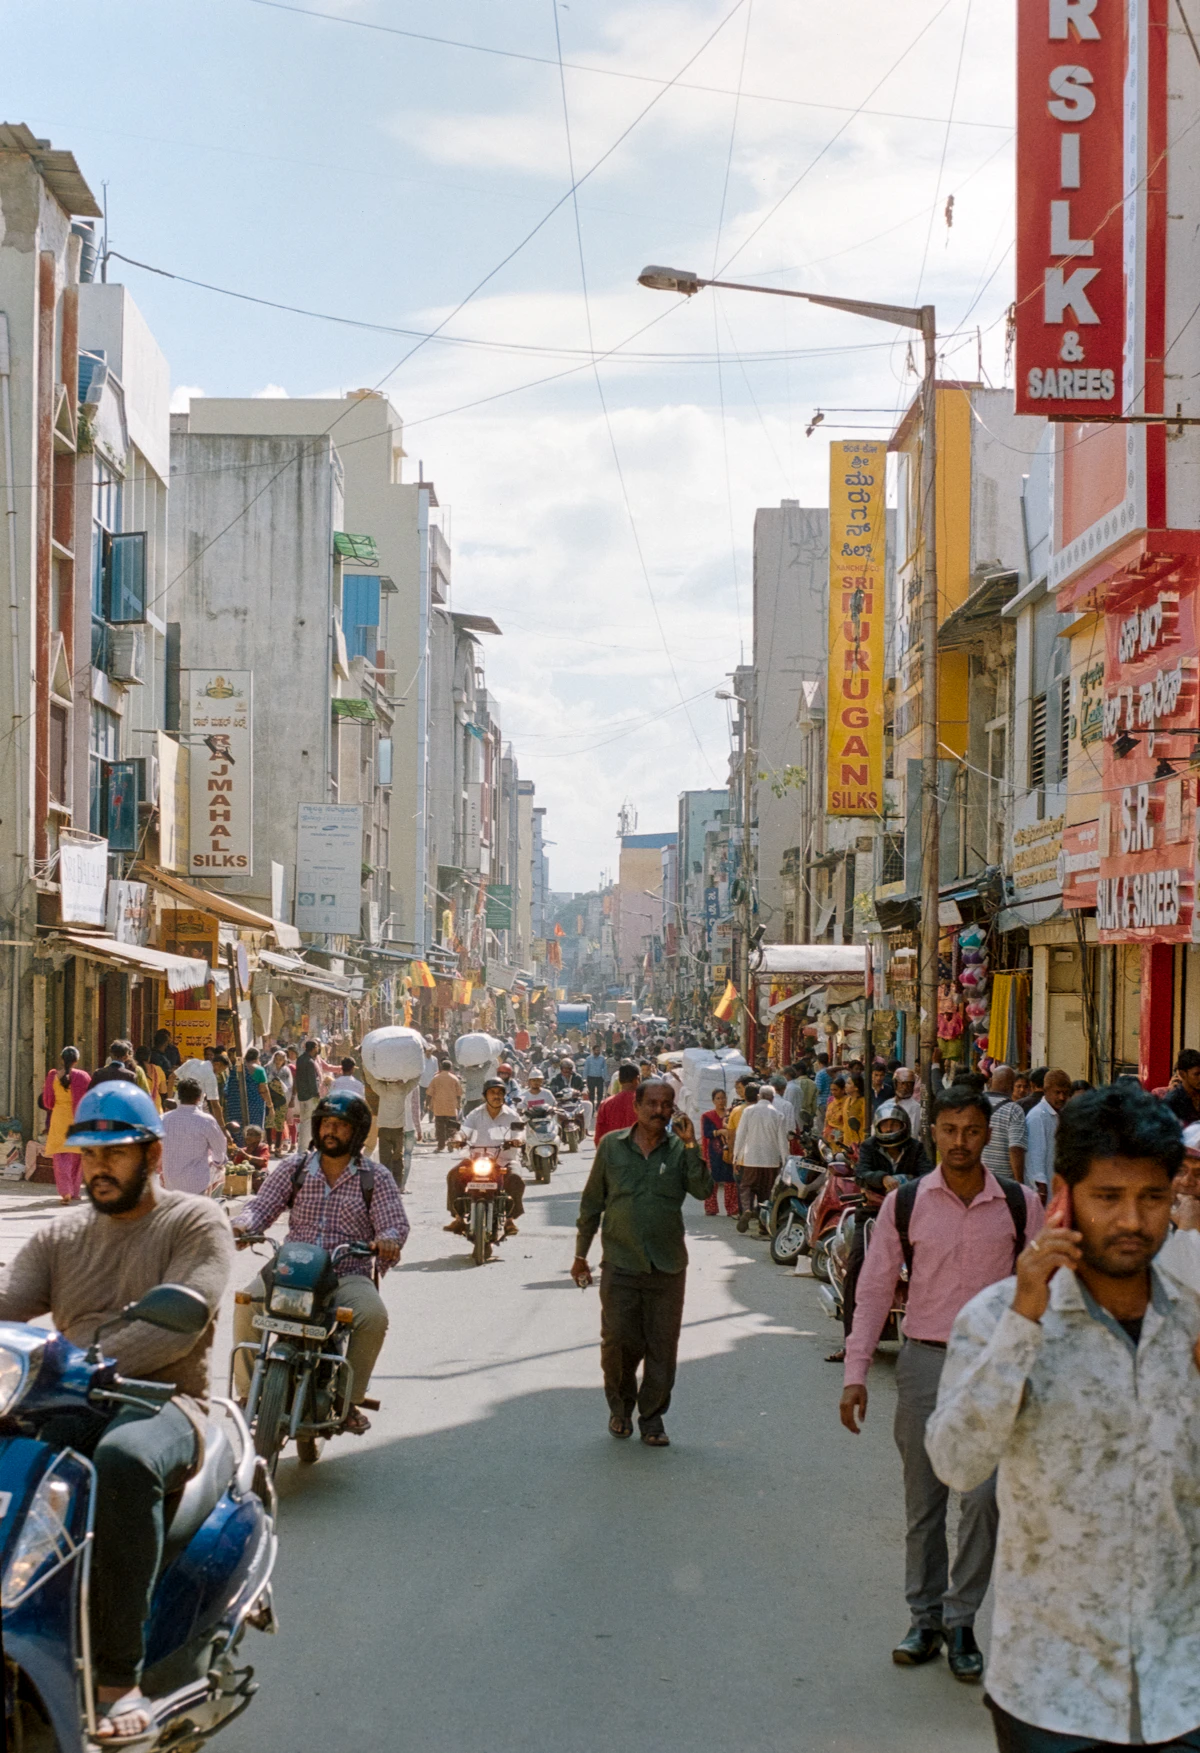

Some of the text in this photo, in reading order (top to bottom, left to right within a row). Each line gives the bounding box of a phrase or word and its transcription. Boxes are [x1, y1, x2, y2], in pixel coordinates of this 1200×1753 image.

[1044, 0, 1101, 324] R SILK
[1060, 331, 1085, 362] &
[1028, 367, 1116, 400] SAREES
[841, 576, 873, 589] SRI
[207, 734, 233, 852] RAJMAHAL
[831, 791, 878, 809] SILKS
[192, 855, 248, 868] SILKS
[1096, 868, 1179, 930] SILK & SAREES
